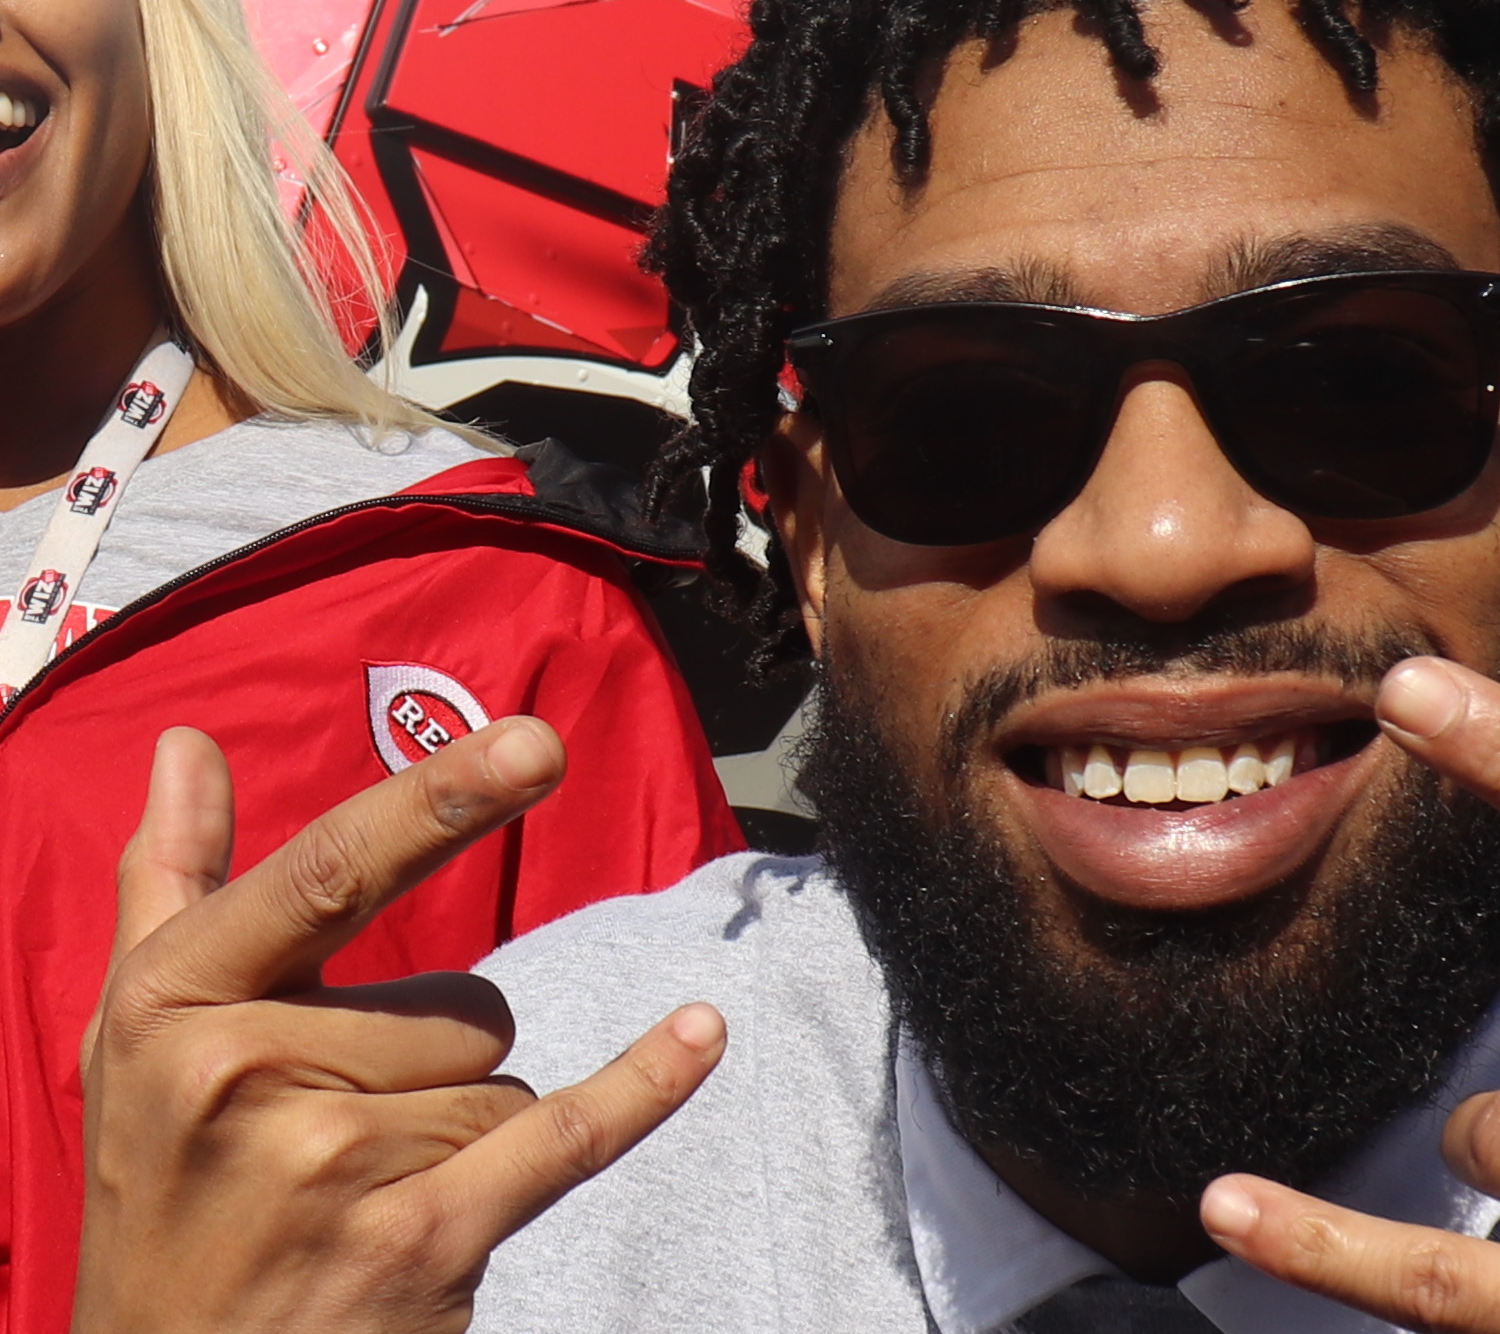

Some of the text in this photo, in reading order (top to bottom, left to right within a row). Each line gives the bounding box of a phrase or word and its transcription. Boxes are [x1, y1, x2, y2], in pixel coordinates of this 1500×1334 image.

[75, 475, 105, 506] WIZ
[27, 579, 56, 616] WIZ
[392, 695, 456, 754] RE
